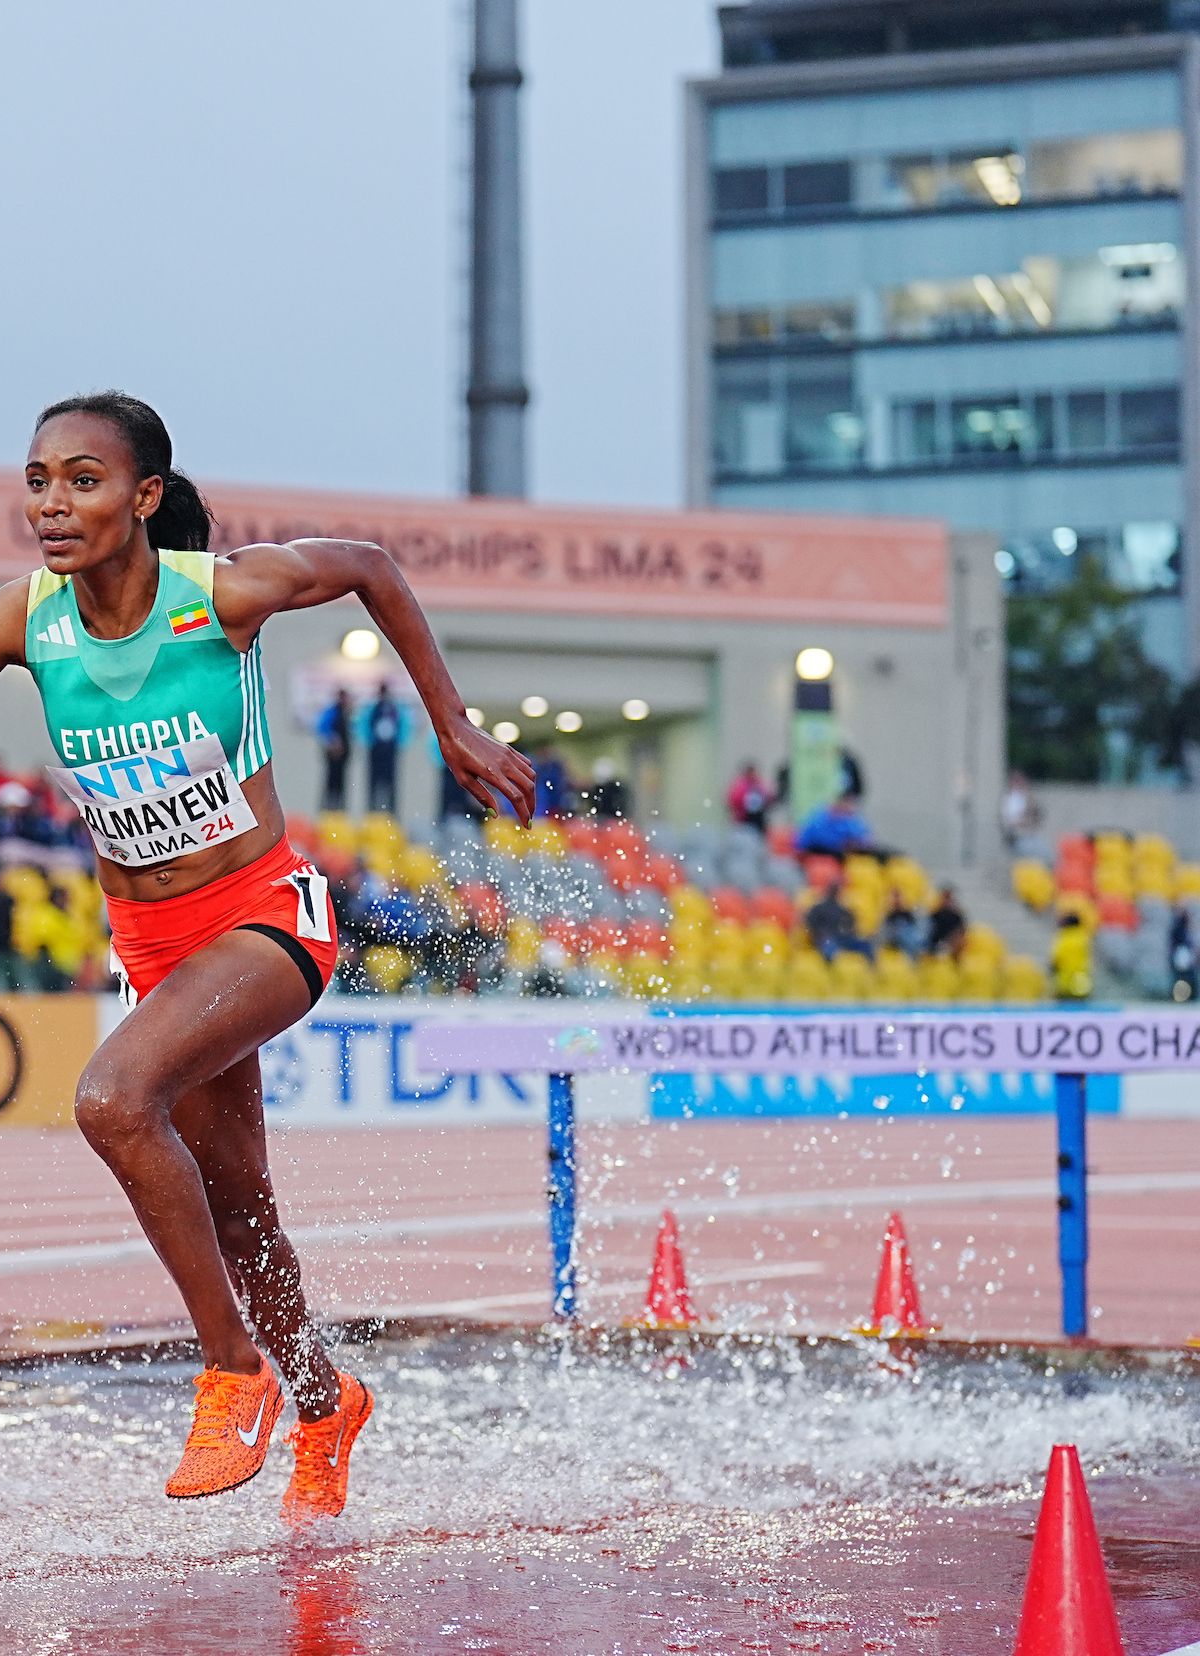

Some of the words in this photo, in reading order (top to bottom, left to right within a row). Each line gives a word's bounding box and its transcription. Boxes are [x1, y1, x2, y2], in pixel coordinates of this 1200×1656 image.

[563, 537, 686, 583] LIMA
[702, 539, 763, 585] 24
[60, 711, 210, 761] ETHIOPIA
[73, 748, 191, 800] NTN
[84, 770, 230, 841] ALMAYEW
[135, 832, 198, 860] LIMA
[201, 813, 234, 842] 24
[611, 1023, 756, 1058] WORLD
[767, 1023, 996, 1059] ATHLETICS
[1016, 1023, 1103, 1060] U20
